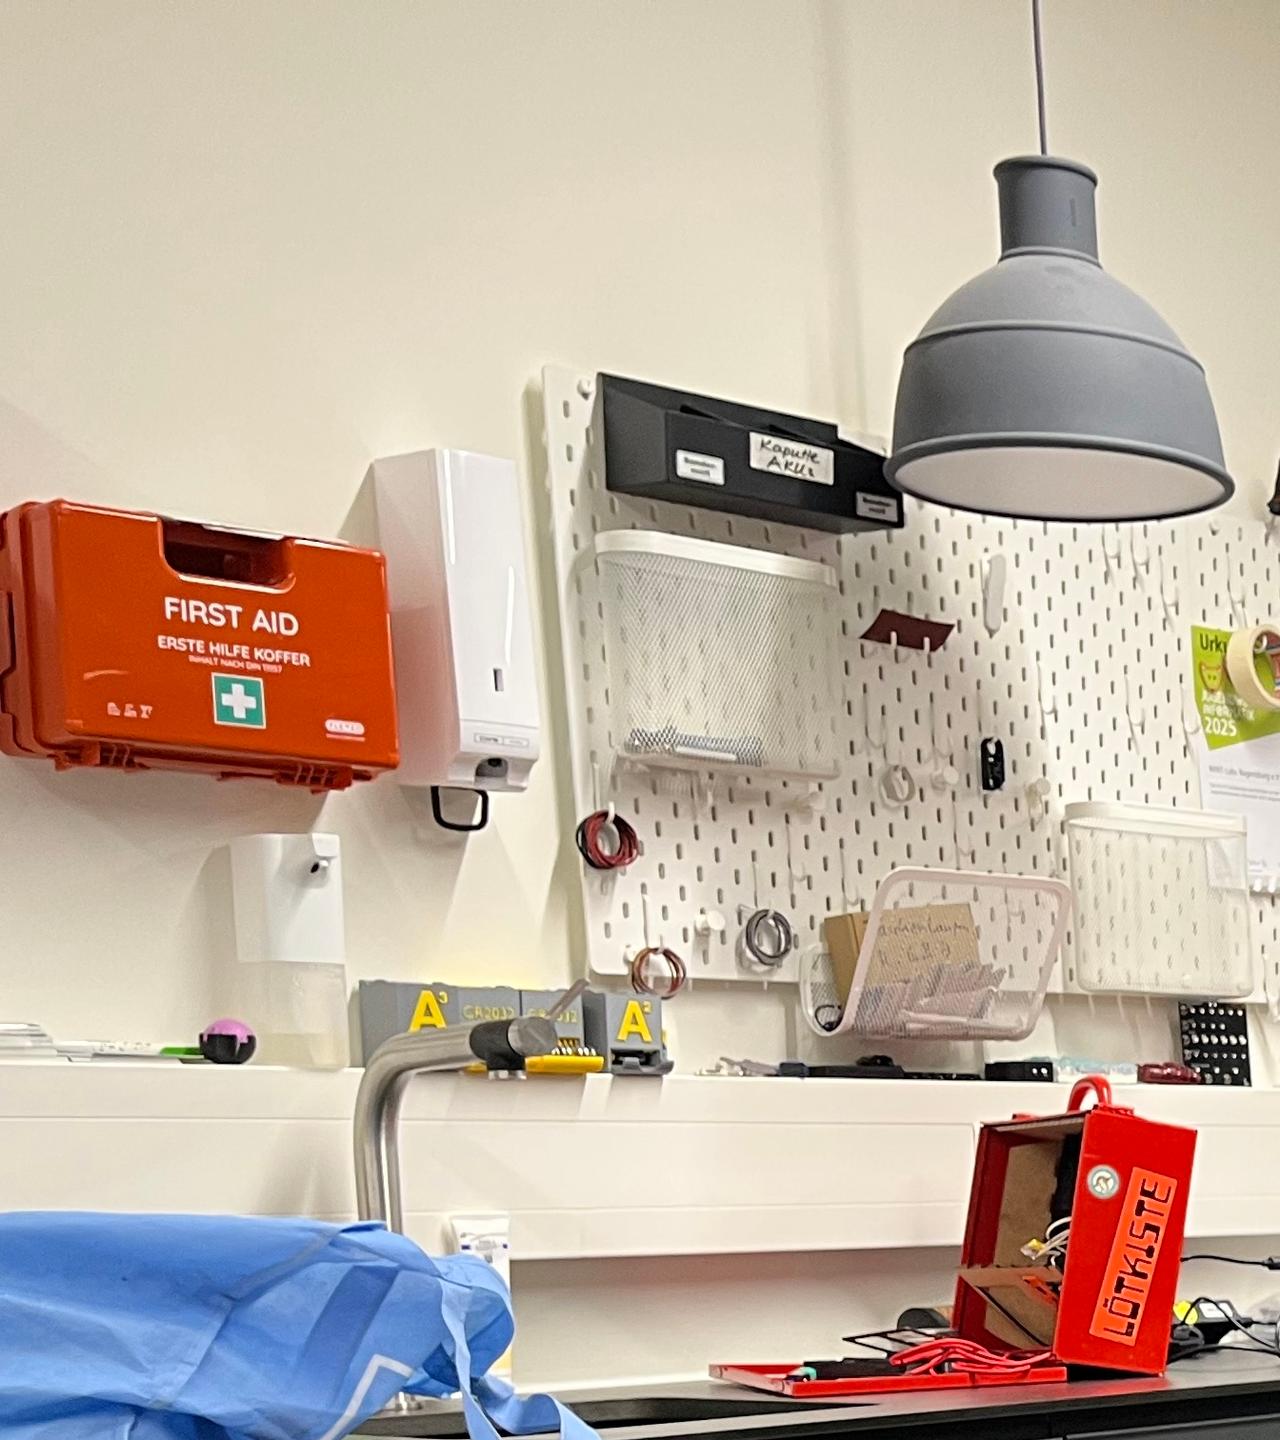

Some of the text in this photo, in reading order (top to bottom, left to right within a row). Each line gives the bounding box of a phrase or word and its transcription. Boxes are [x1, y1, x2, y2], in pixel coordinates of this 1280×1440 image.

[164, 596, 300, 637] FIRST AID
[157, 634, 311, 668] ERSTE HILFE KOFFER
[1204, 716, 1237, 737] 2025
[1102, 1177, 1172, 1338] LÖTKISTE
